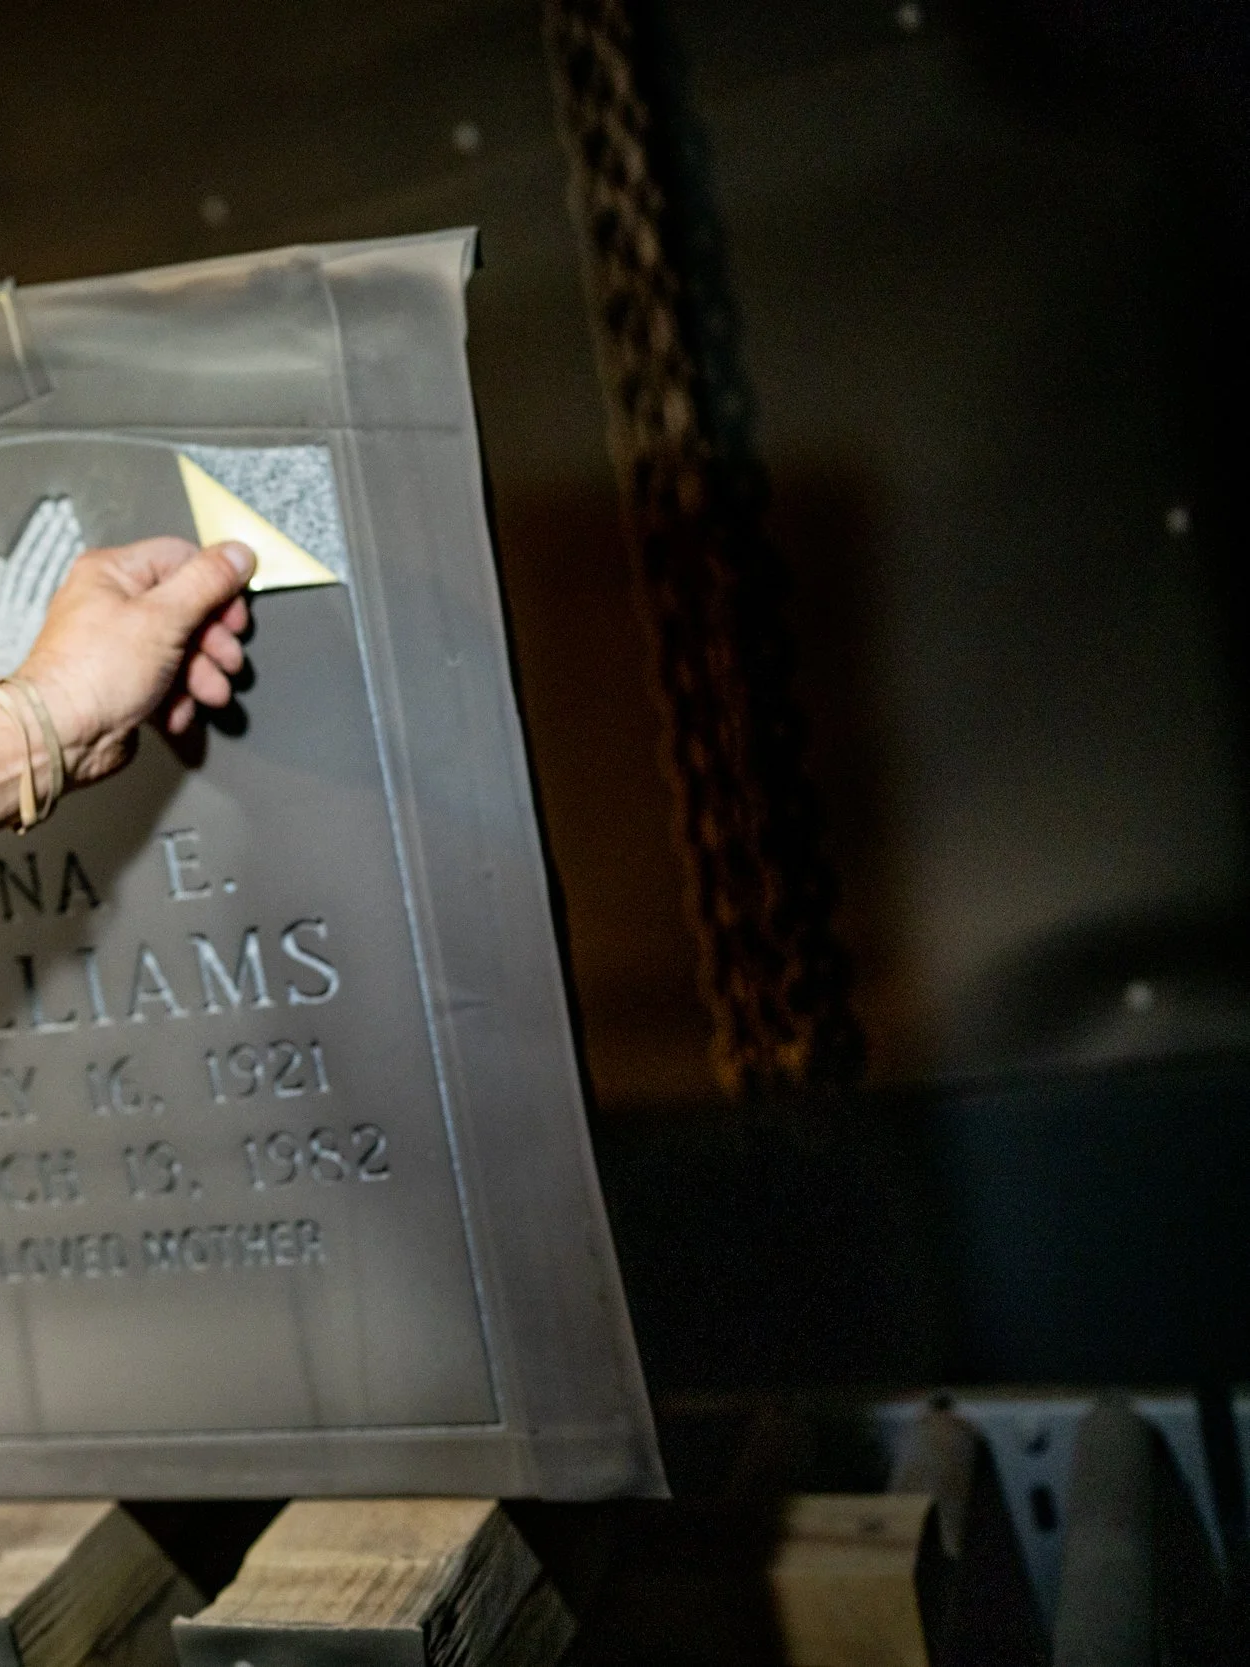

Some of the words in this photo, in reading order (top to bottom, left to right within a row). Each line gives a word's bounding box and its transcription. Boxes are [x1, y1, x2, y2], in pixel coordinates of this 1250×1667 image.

[158, 826, 238, 900] E.
[203, 1037, 332, 1104] 1921
[243, 1122, 391, 1192] 1982
[141, 1216, 329, 1275] MOTHER
